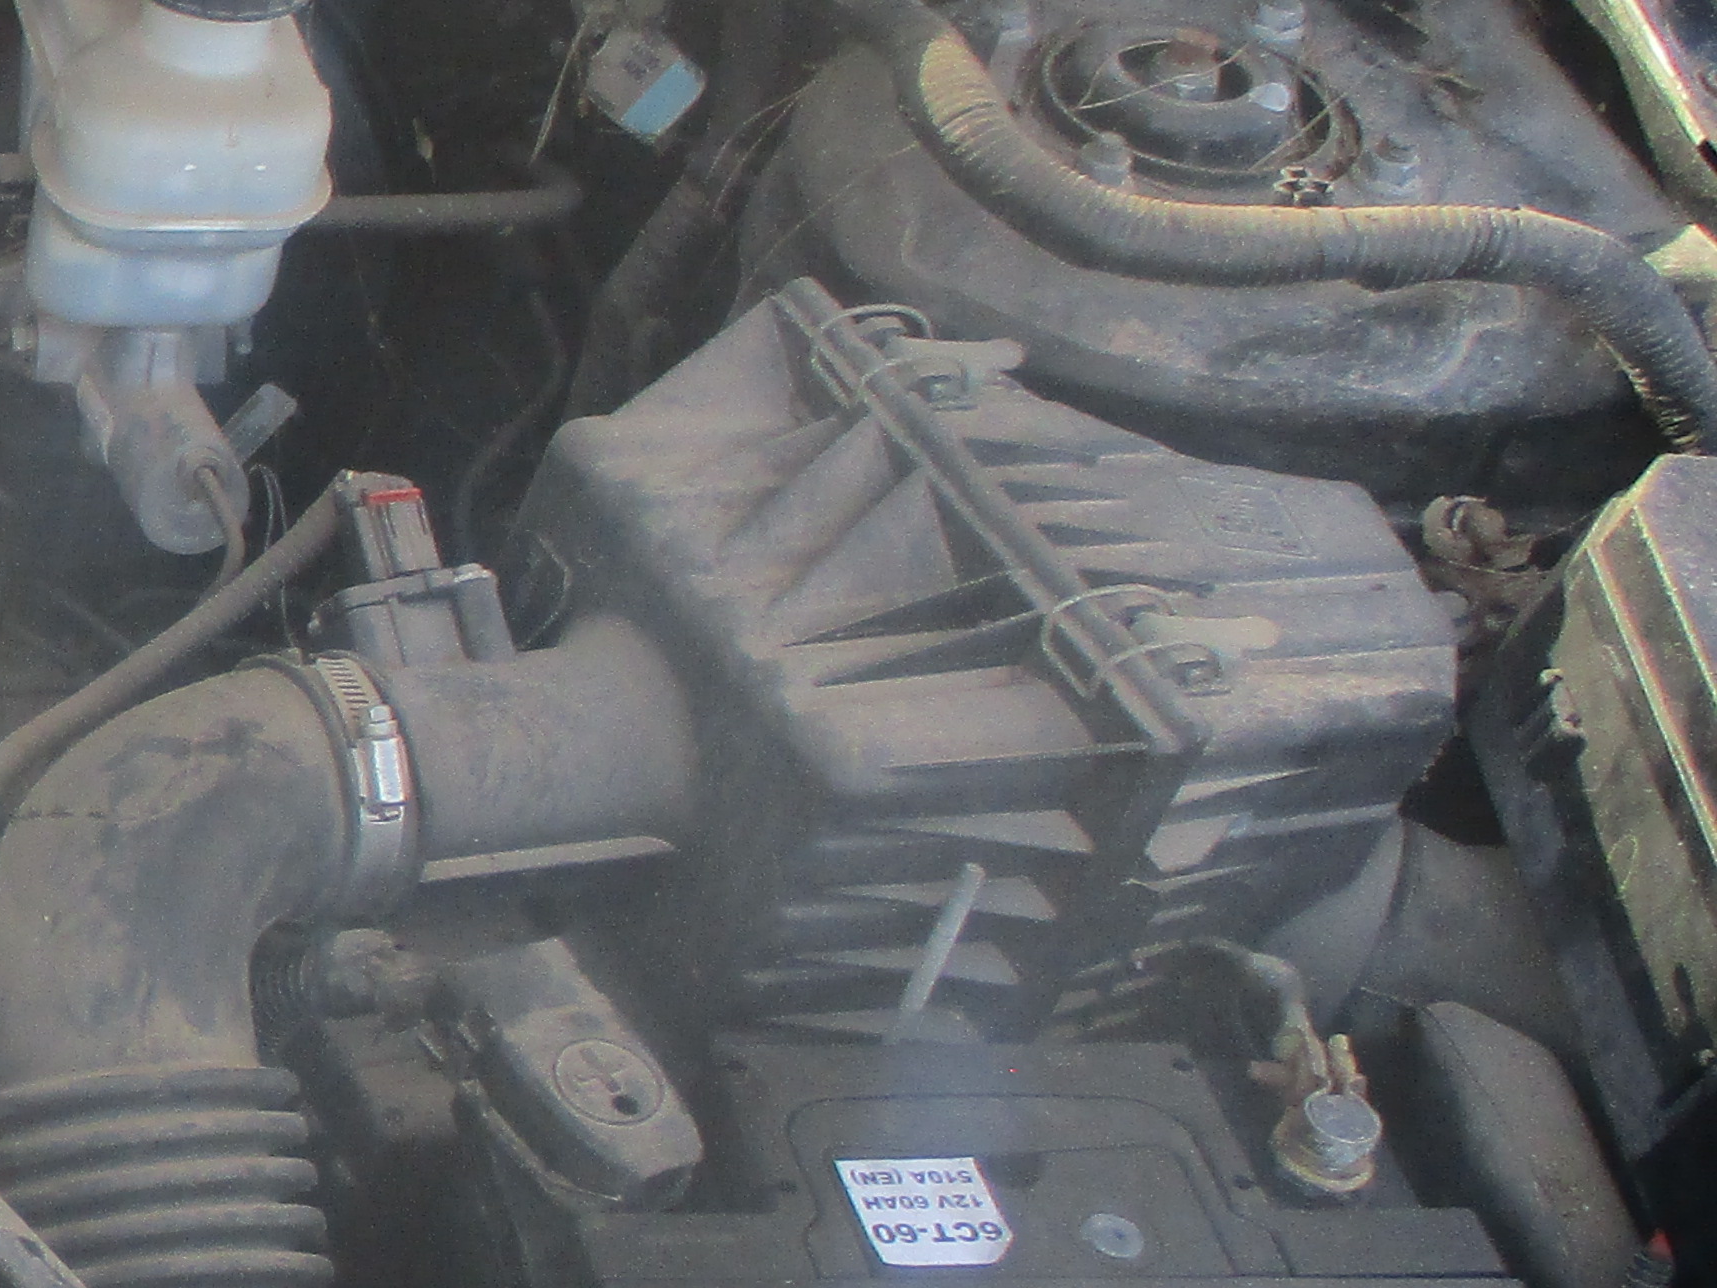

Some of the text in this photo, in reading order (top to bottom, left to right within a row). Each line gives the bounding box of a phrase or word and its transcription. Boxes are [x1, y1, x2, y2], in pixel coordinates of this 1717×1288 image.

[849, 1168, 974, 1186] 510A (EN)
[861, 1194, 984, 1210] 12V 60AH
[872, 1221, 1004, 1244] 6CT-60
